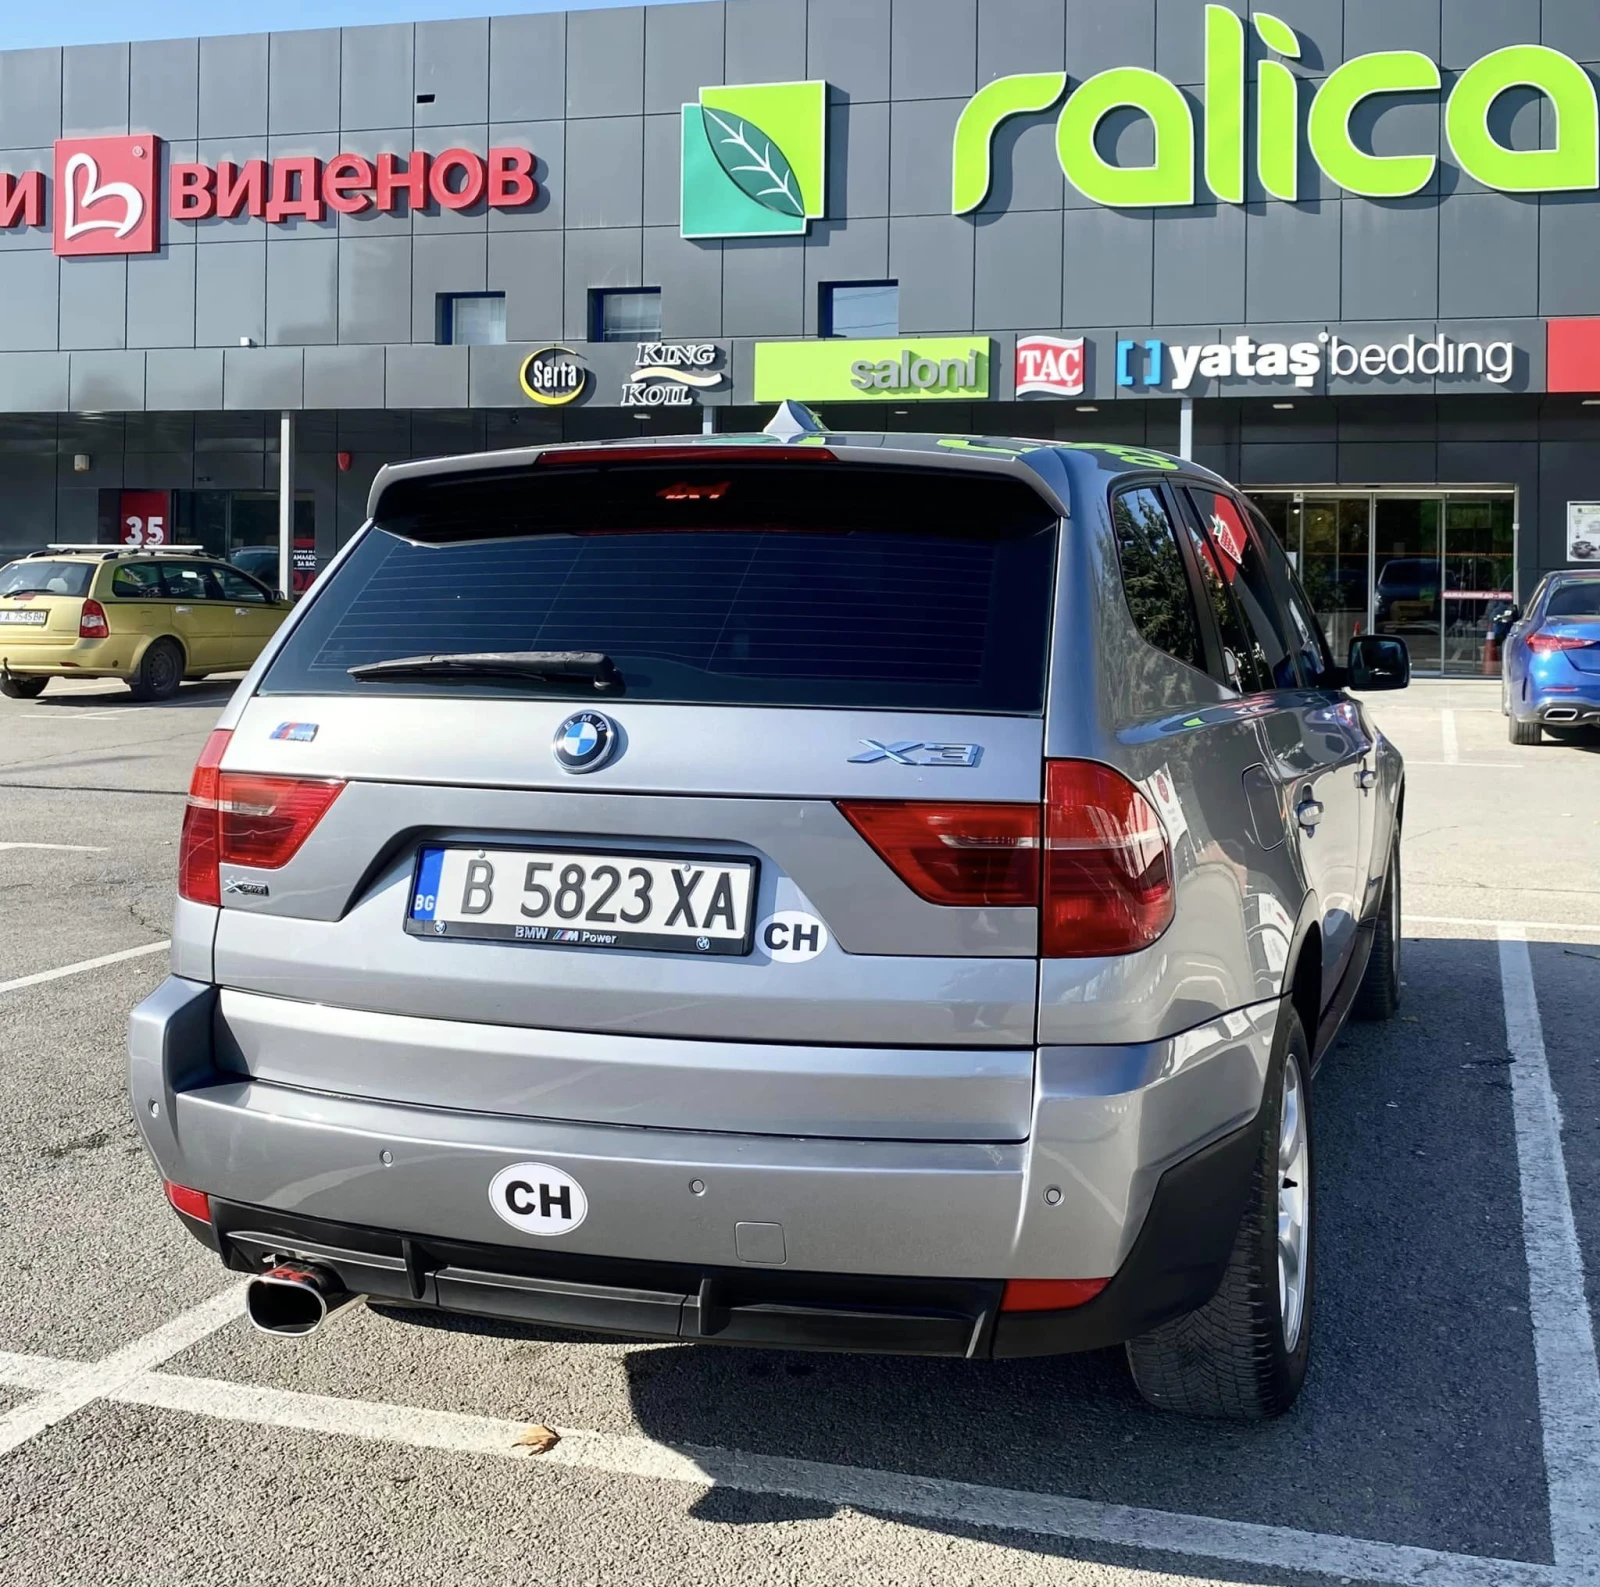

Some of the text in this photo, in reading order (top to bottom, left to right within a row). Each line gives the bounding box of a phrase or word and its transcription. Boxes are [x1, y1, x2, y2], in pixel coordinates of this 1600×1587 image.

[952, 4, 1599, 215] ralica
[635, 342, 716, 366] KING
[1019, 348, 1080, 387] TAÇ
[1169, 332, 1513, 390] yataş bedding
[533, 360, 577, 388] Serta
[850, 348, 977, 390] saloni
[620, 383, 693, 406] KOIL
[125, 516, 164, 545] 35
[564, 714, 607, 732] BMW
[847, 738, 983, 767] X3
[413, 894, 435, 912] BG
[520, 861, 654, 924] 5823
[664, 868, 737, 931] XA
[515, 925, 549, 940] BMW
[582, 931, 617, 944] Power
[764, 921, 820, 952] CH
[504, 1179, 572, 1220] CH
